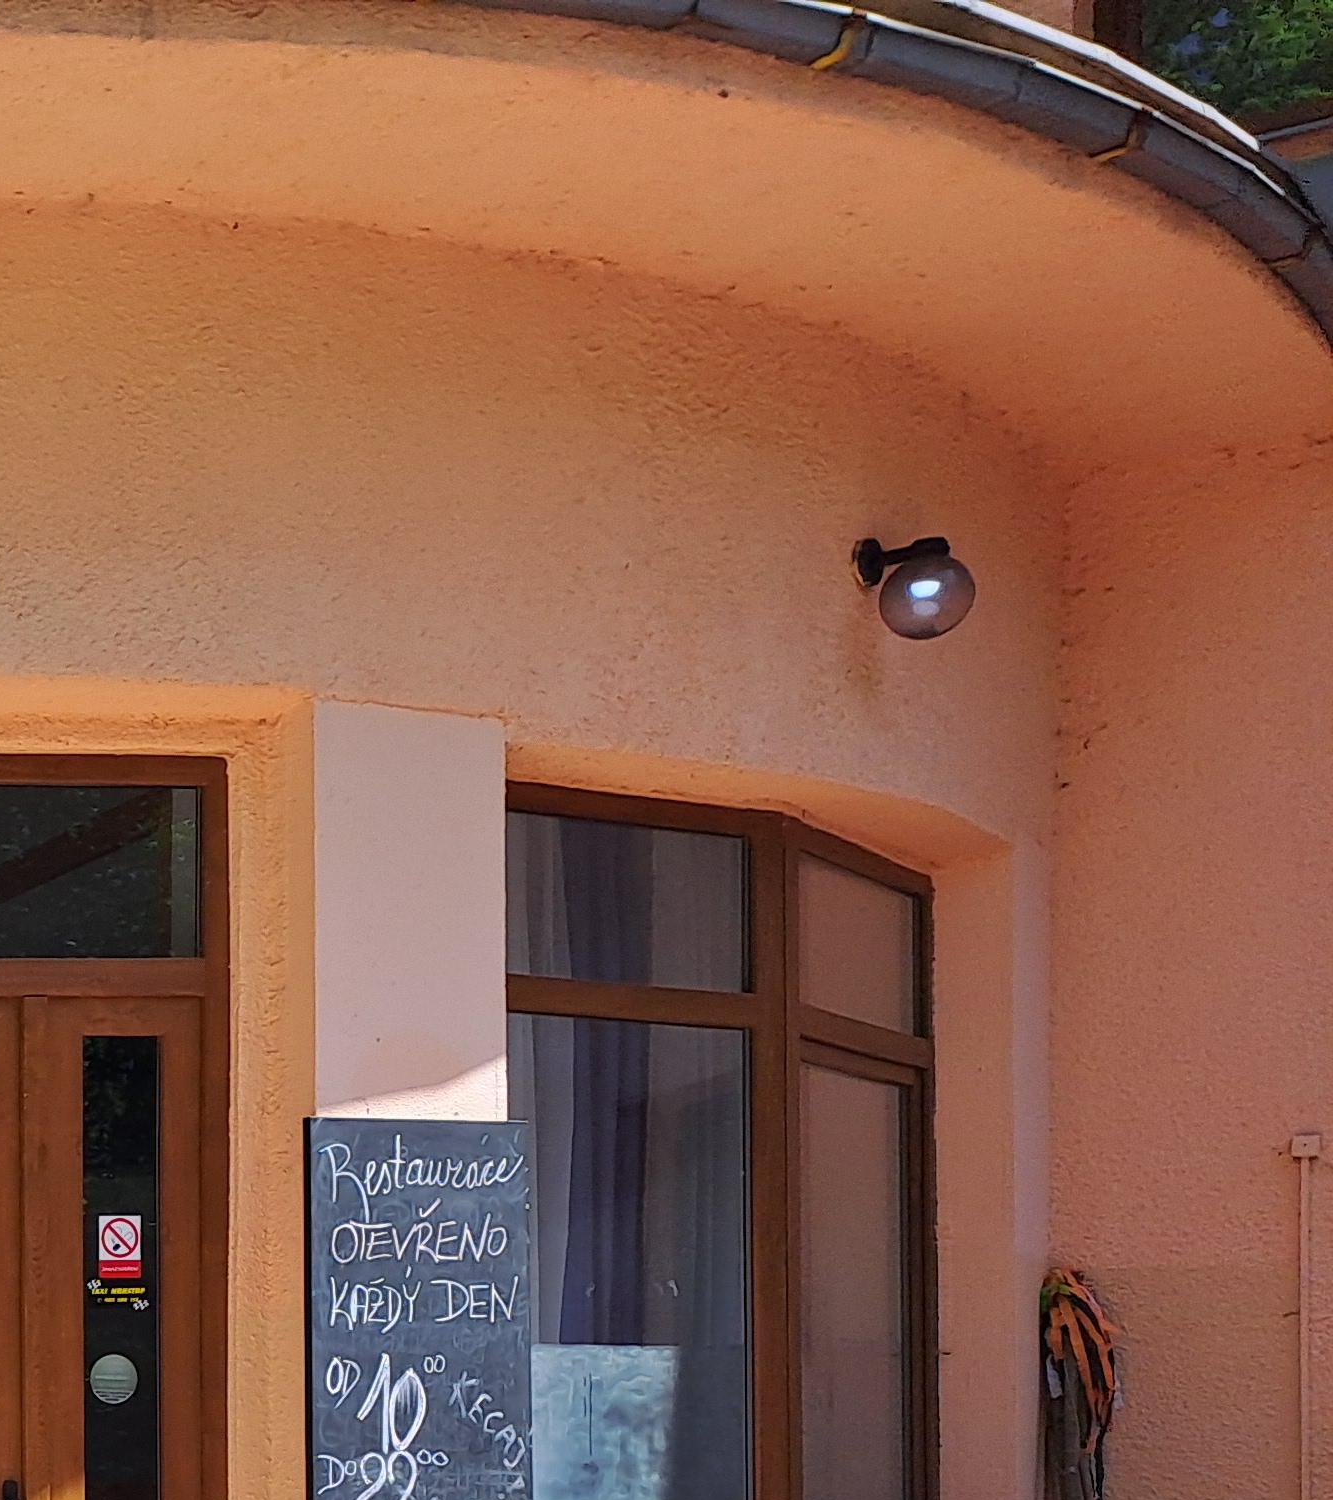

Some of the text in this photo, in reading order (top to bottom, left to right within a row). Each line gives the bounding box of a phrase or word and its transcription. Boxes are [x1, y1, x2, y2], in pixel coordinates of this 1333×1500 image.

[318, 1133, 525, 1223] Restaurace
[331, 1198, 508, 1264] OTEVŘENO
[329, 1265, 519, 1334] KAŽDÝ DEN
[326, 1355, 361, 1409] OD
